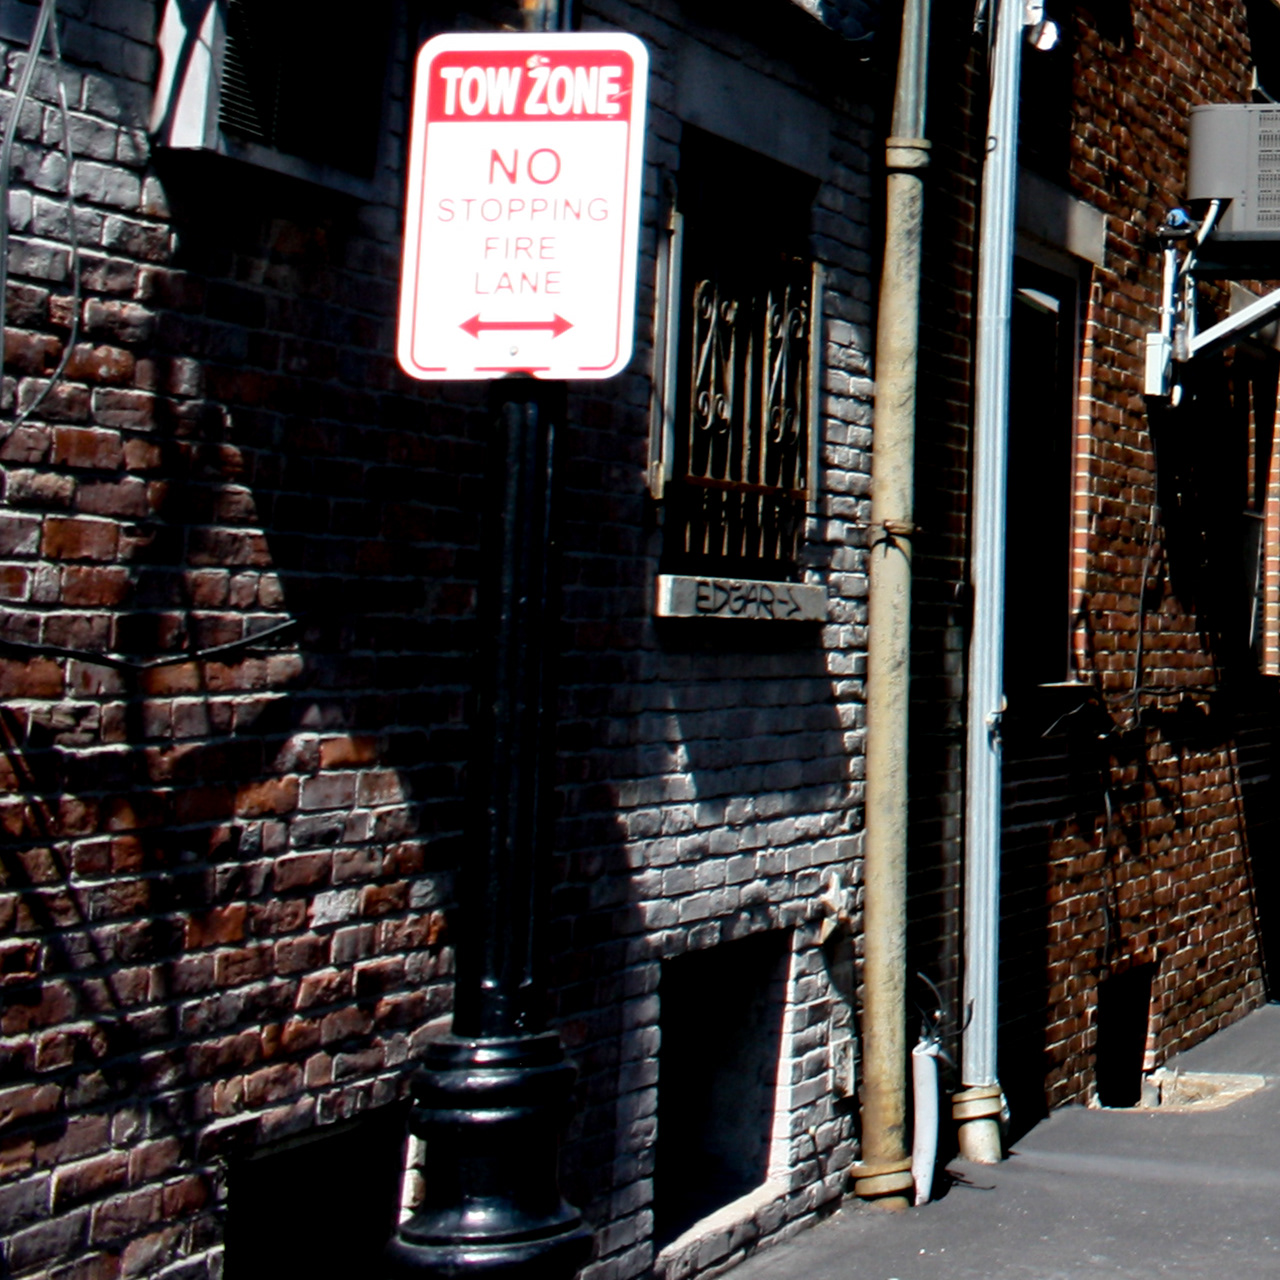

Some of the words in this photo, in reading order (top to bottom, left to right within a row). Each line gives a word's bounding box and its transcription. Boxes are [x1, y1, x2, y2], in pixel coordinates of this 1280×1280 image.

[440, 66, 521, 116] TOW
[524, 65, 622, 116] ZONE
[489, 148, 562, 185] NO
[438, 197, 609, 222] STOPPING
[484, 237, 556, 260] FIRE
[475, 271, 561, 295] LANE
[696, 580, 775, 619] EDGAR
